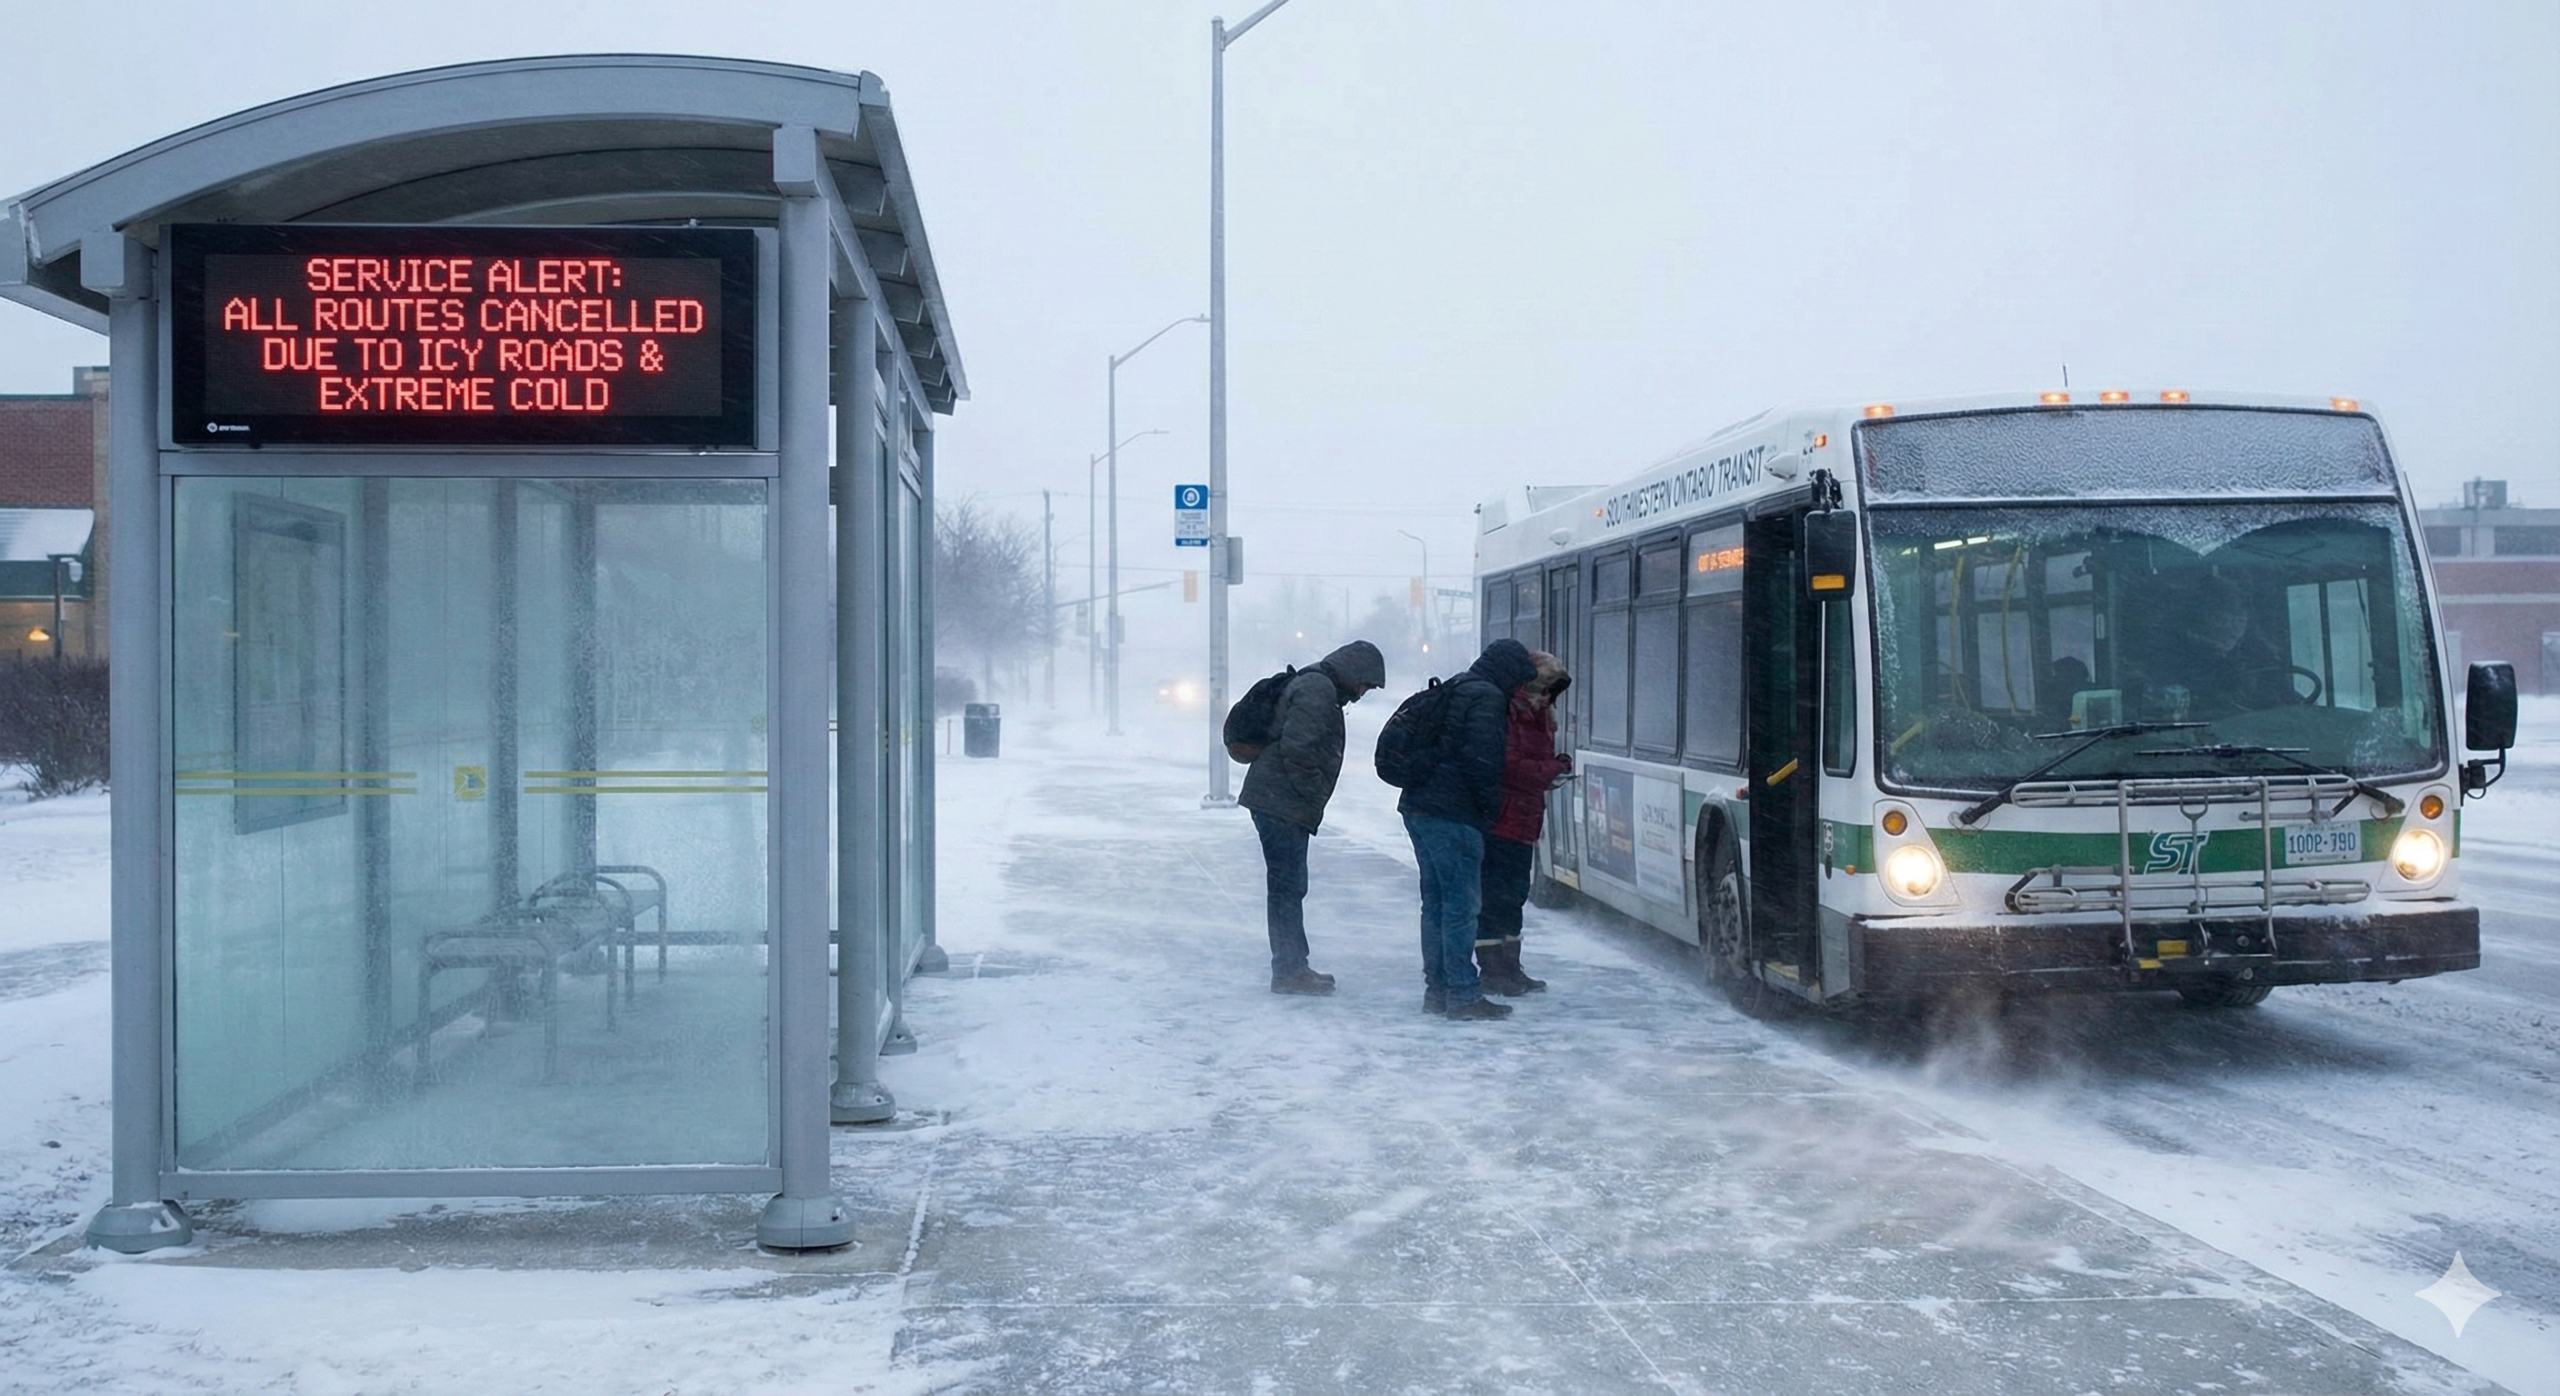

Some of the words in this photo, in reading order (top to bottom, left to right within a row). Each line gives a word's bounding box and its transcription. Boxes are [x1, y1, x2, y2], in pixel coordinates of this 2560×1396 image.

[306, 258, 473, 293] SERVICE
[487, 258, 622, 293] ALERT:
[223, 296, 299, 332] ALL
[314, 297, 465, 333] ROUTES
[480, 297, 704, 334] CANCELLED
[262, 337, 339, 371] DUE
[353, 337, 404, 372] TO
[418, 337, 484, 372] ICY
[499, 338, 624, 372] ROADS
[639, 339, 665, 372] &
[319, 376, 496, 411] EXTREME
[510, 376, 610, 411] COLD
[1606, 477, 1673, 528] SOUTHWESTERN
[1673, 461, 1716, 507] ONTARIO
[1718, 445, 1766, 494] TRANSIT
